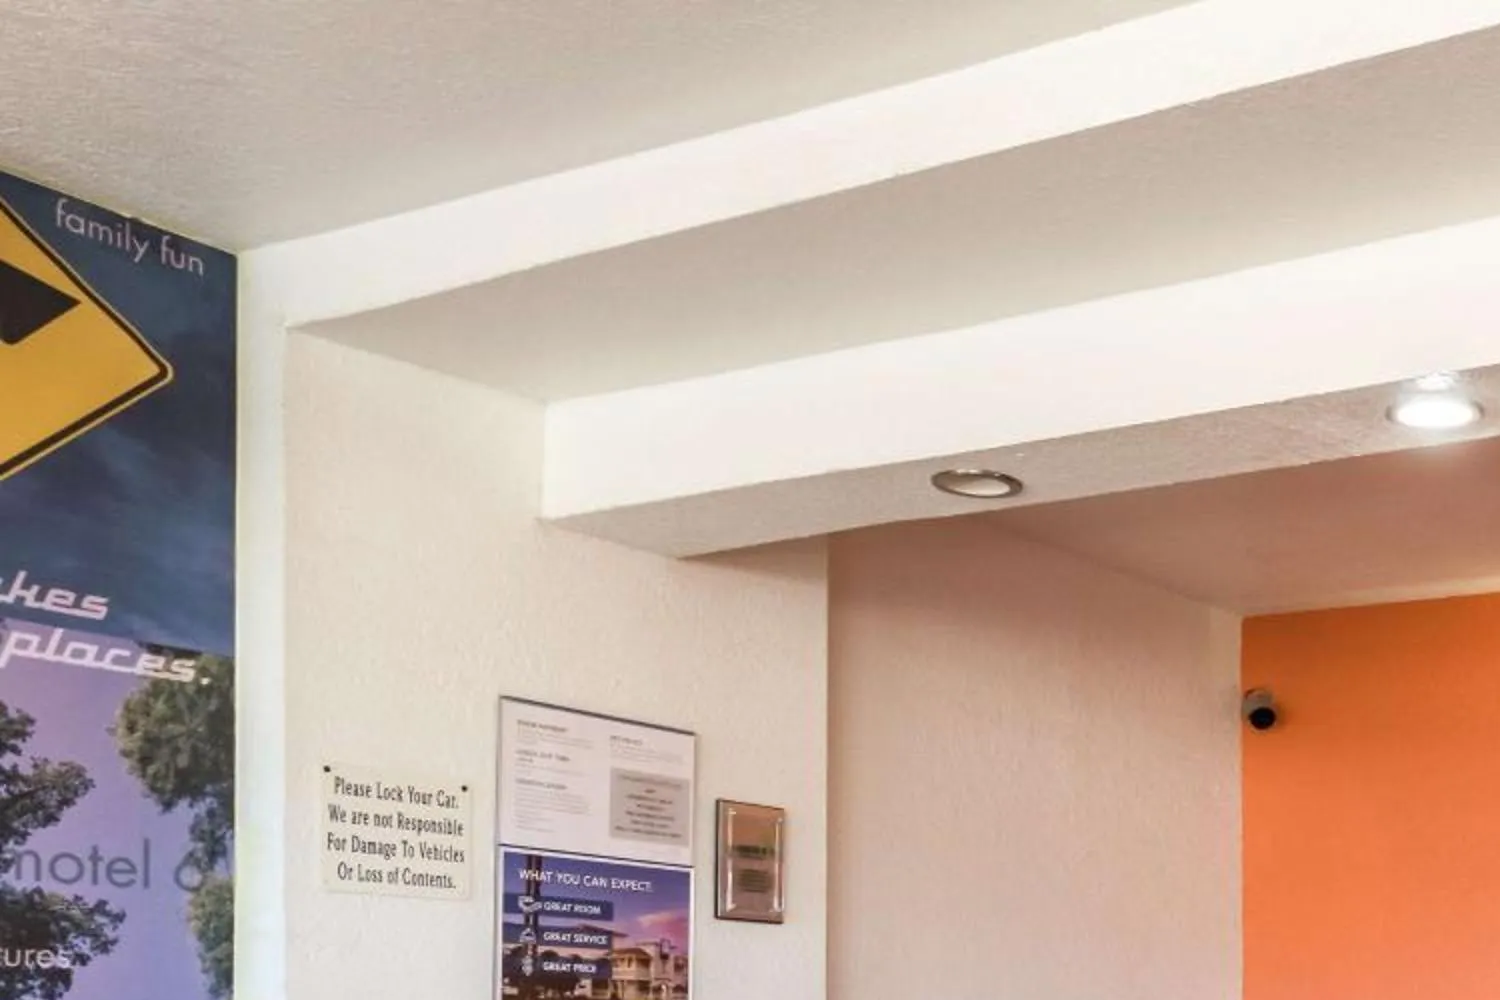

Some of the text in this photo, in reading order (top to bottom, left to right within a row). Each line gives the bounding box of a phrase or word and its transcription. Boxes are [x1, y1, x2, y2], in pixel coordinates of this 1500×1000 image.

[56, 198, 204, 276] family fun
[0, 570, 109, 620] kes
[0, 628, 210, 685] places.
[334, 776, 459, 809] Please Lock Your Car.
[328, 804, 464, 836] We are not Responsible
[327, 832, 465, 863] For Damage To Vehicles
[337, 861, 457, 889] Or Loss of Contents.
[519, 870, 553, 882] WHAT
[556, 872, 580, 885] YOU
[583, 875, 606, 888] CAN
[543, 902, 601, 914] GREAT ROOM
[543, 931, 609, 945] GREAT SERVICE
[0, 946, 71, 968] ures
[543, 961, 571, 972] GREAT
